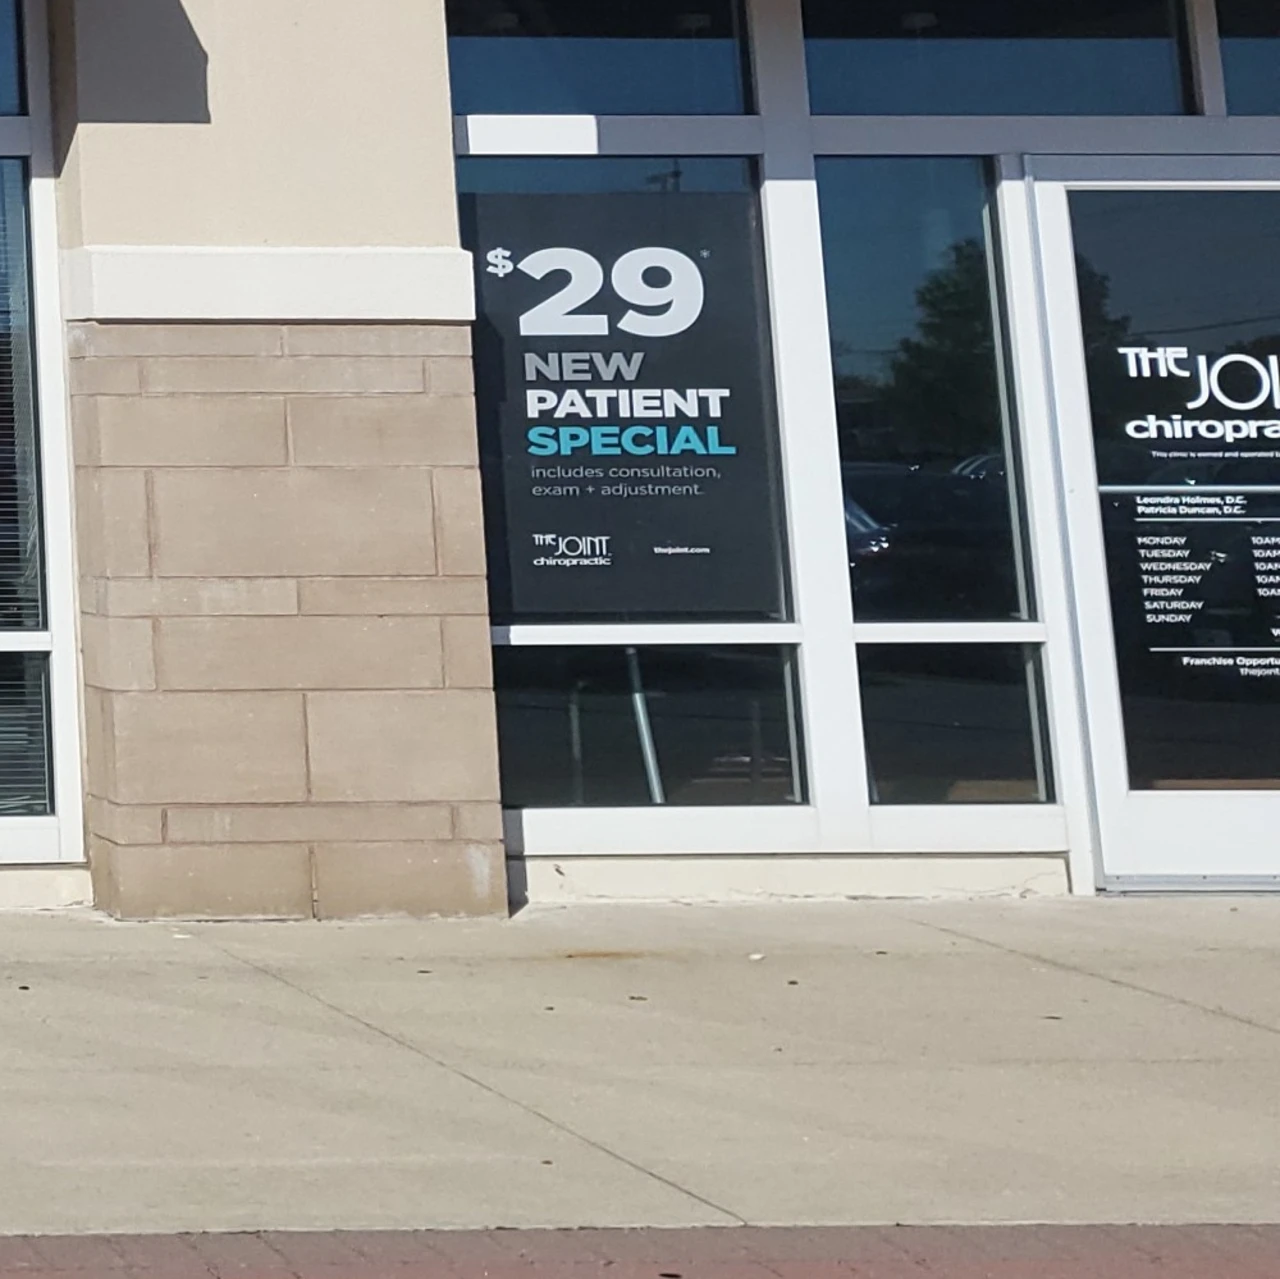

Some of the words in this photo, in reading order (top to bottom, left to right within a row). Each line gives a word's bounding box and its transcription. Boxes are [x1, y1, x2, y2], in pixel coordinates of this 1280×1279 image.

[523, 352, 645, 381] NEW
[1118, 346, 1191, 378] THE
[525, 389, 731, 419] PATIENT
[1126, 415, 1280, 443] chiropra
[527, 425, 737, 456] SPECIAL
[531, 466, 605, 479] includes
[608, 466, 722, 480] consultation,
[532, 485, 580, 496] exam
[601, 483, 705, 498] adjustment.
[1137, 506, 1177, 514] Patricia
[1179, 506, 1222, 515] Duncan,
[533, 534, 556, 545] THE
[554, 536, 611, 556] JOINT
[1137, 536, 1187, 545] MONDAY
[654, 546, 710, 554] thejoint.com
[1138, 549, 1190, 558] TUESDAY
[533, 557, 611, 566] chiropractic
[1139, 562, 1212, 571] WEDNESDAY
[1141, 575, 1202, 584] THURSDAY
[1142, 588, 1183, 597] FRIDAY
[1144, 601, 1204, 610] SATURDAY
[1146, 614, 1192, 623] SUNDAY
[1182, 656, 1234, 665] Franchise
